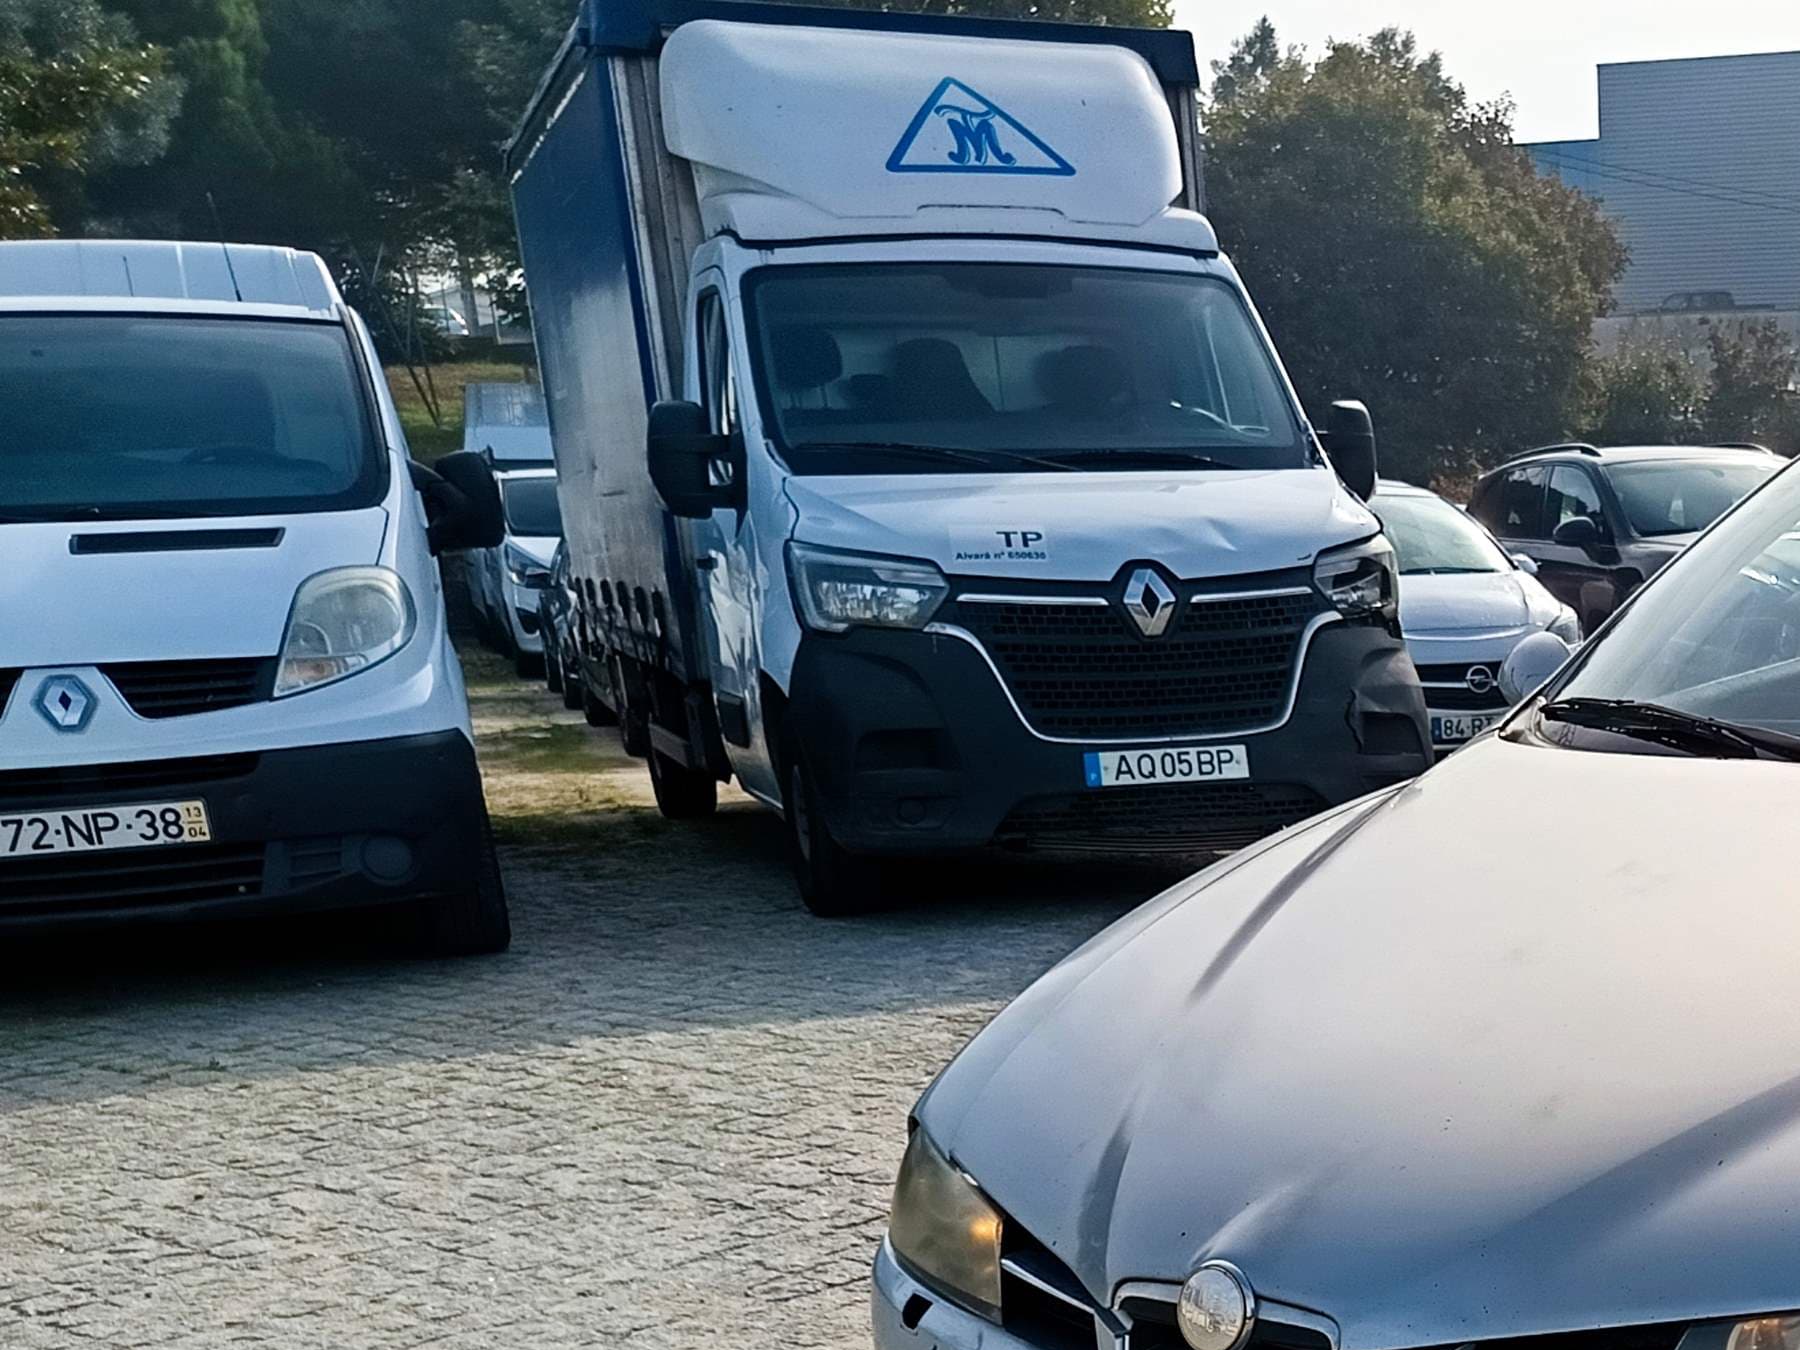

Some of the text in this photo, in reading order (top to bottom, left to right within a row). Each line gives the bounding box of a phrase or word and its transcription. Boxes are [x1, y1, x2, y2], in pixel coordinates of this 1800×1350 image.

[995, 531, 1043, 548] TP
[185, 806, 202, 818] 13
[188, 827, 207, 838] 04
